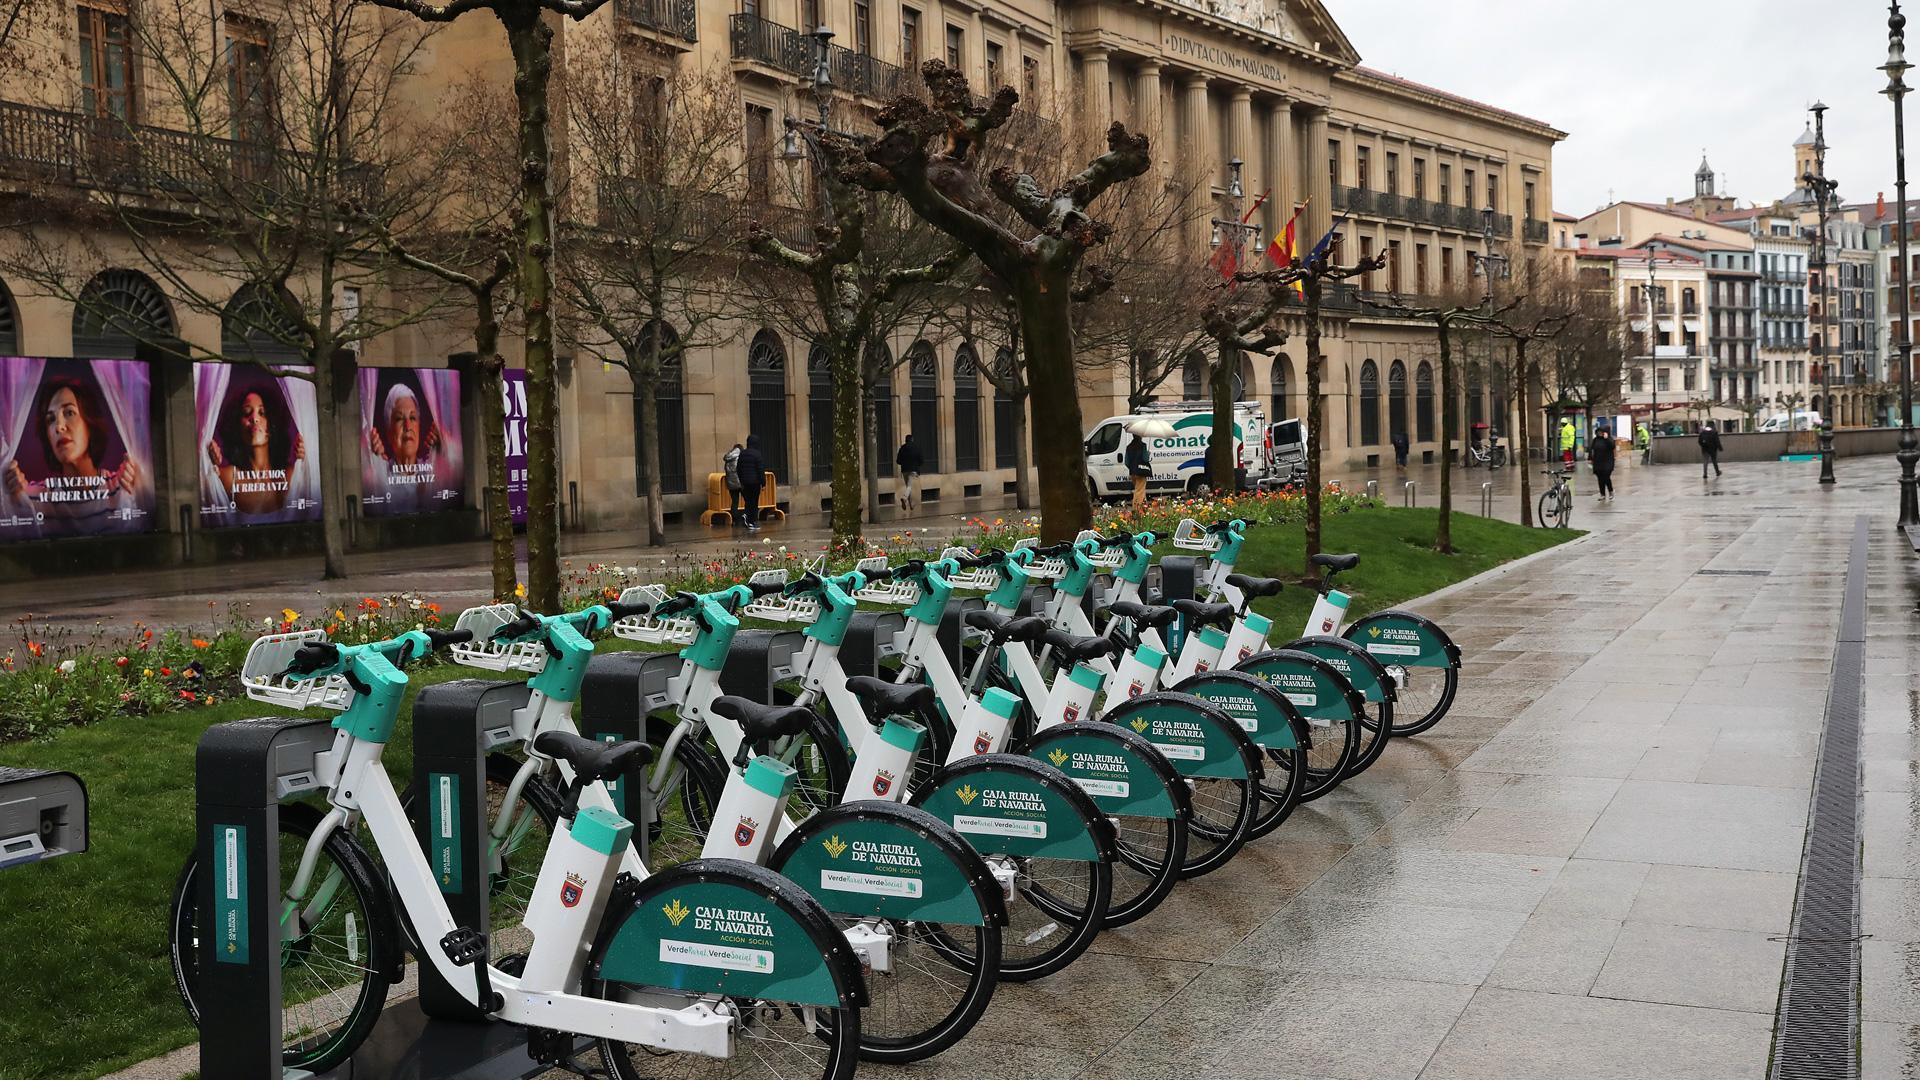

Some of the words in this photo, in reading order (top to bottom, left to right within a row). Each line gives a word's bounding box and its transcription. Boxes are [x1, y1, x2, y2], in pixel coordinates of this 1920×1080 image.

[1242, 58, 1282, 82] NAVARRA
[1153, 434, 1206, 449] conat
[237, 469, 286, 480] AVANCEMOS
[45, 476, 107, 488] AVANCEMOS
[233, 481, 288, 493] AURRERANTZ
[40, 489, 110, 503] AURRERANTZ
[1282, 680, 1316, 688] NAVARRA
[1229, 696, 1254, 704] RURAL
[1221, 703, 1257, 712] NAVARRA
[1152, 720, 1172, 729] CAJA
[1173, 721, 1201, 731] RURAL
[1165, 729, 1205, 738] NAVARRA
[1072, 752, 1094, 762] CAJA
[1095, 754, 1126, 765] RURAL
[1072, 760, 1084, 769] DE
[1086, 762, 1129, 773] NAVARRA
[982, 789, 1007, 800] CAJA
[1008, 791, 1042, 802] RURAL
[982, 798, 996, 808] DE
[998, 800, 1047, 812] NAVARRA
[852, 841, 879, 853] CAJA
[879, 844, 917, 856] RURAL
[852, 851, 867, 862] DE
[870, 852, 922, 867] NAVARRA
[695, 906, 726, 920] CAJA
[726, 910, 769, 924] RURAL
[694, 918, 712, 930] DE
[714, 920, 774, 937] NAVARRA
[748, 938, 774, 946] SOCIAL
